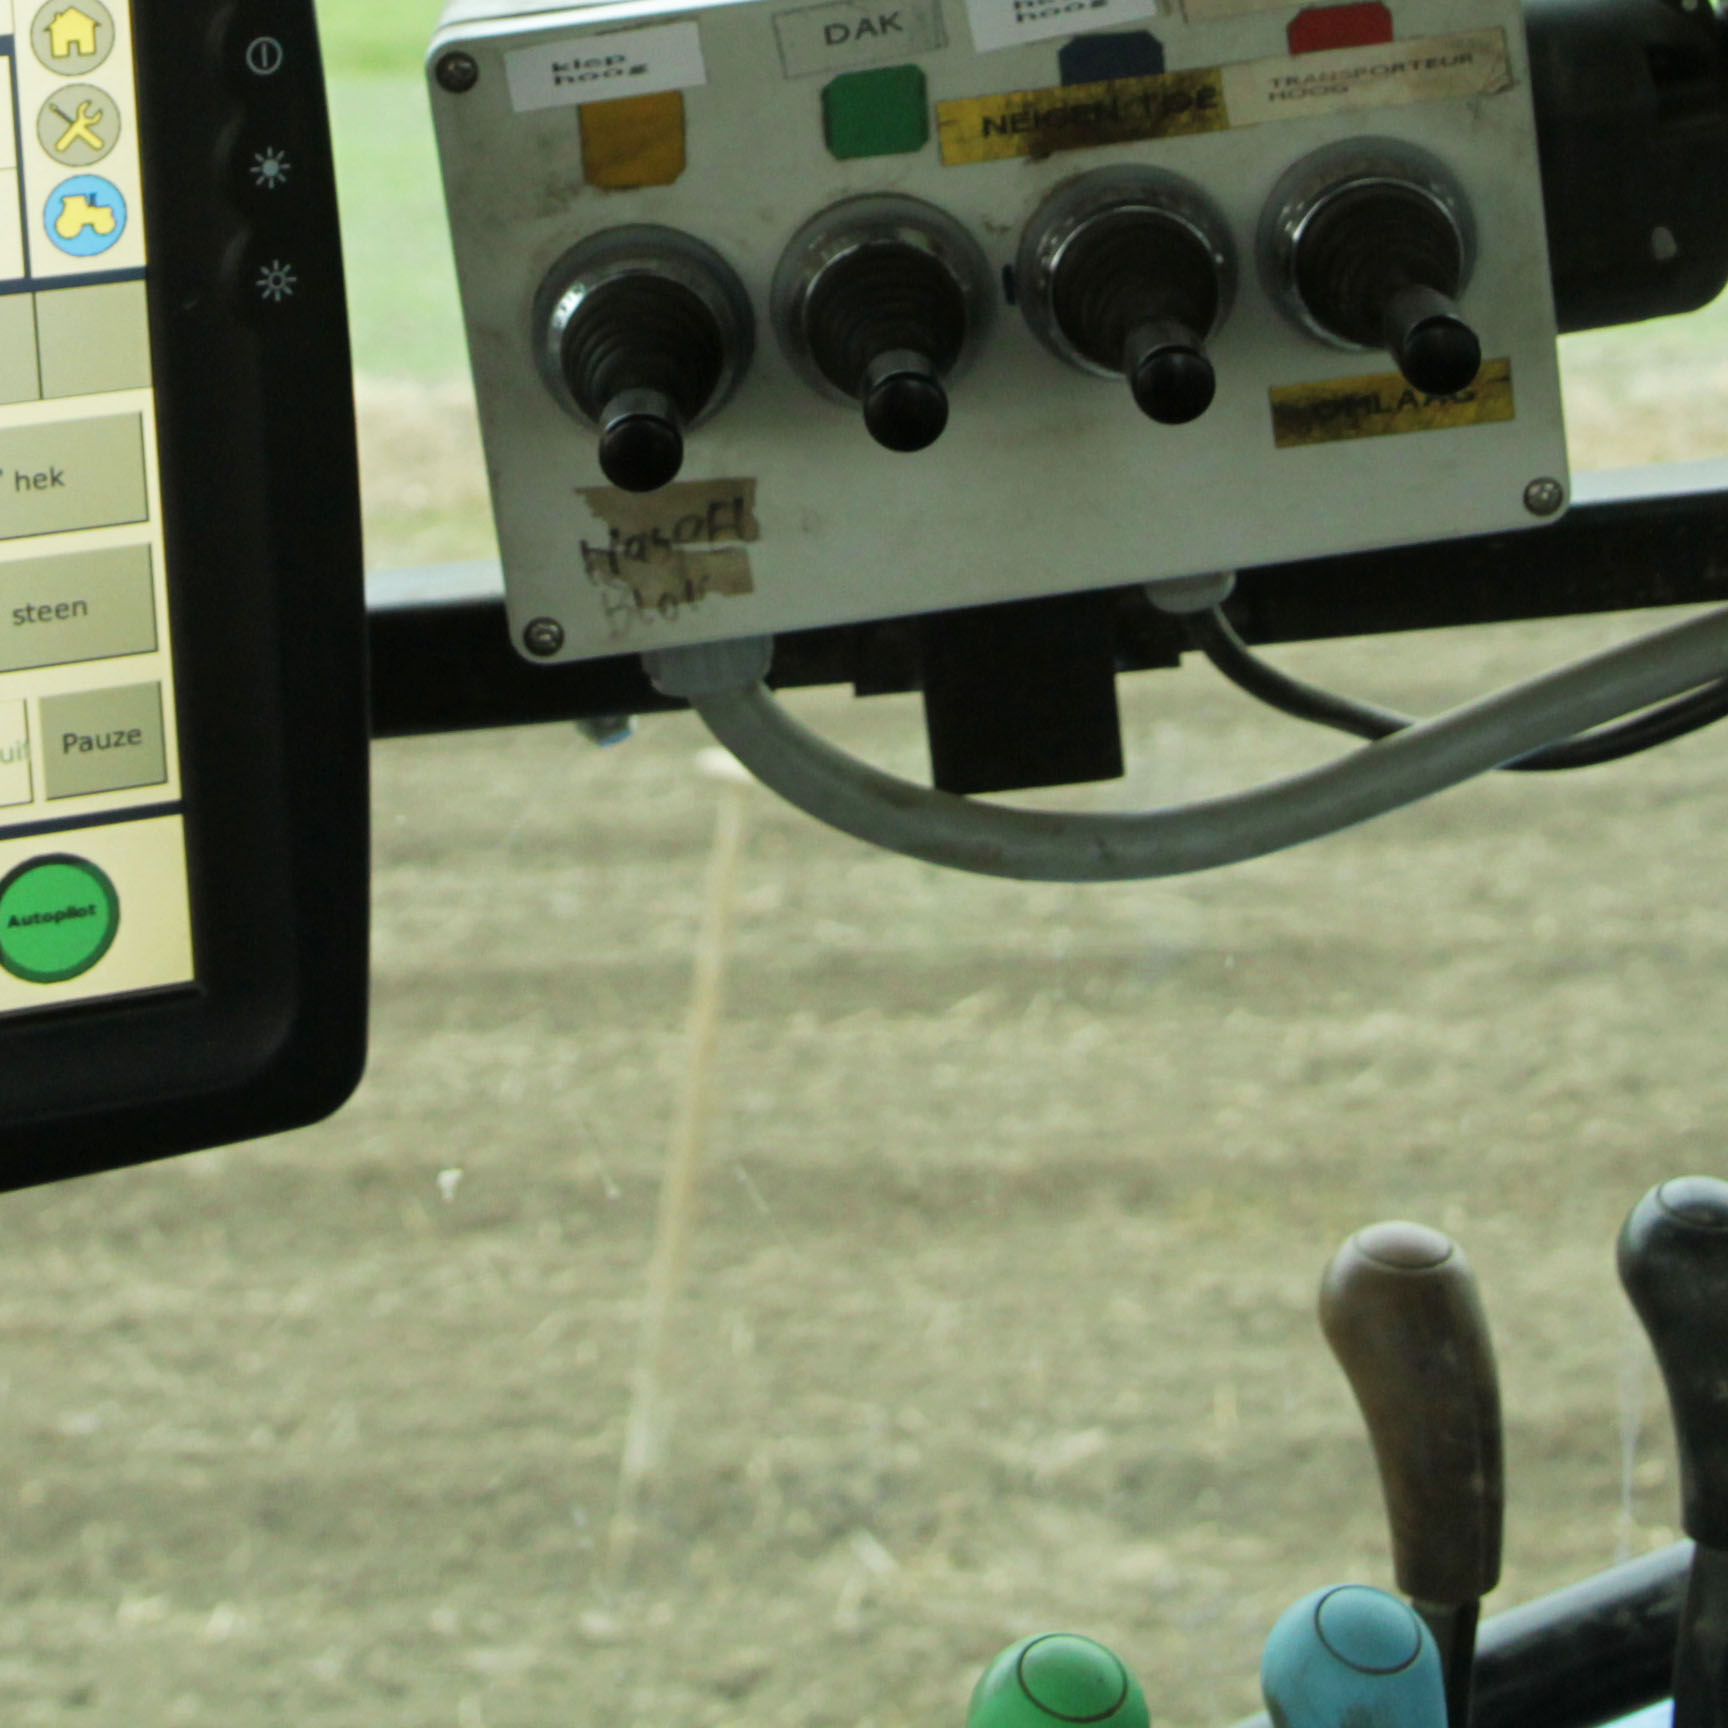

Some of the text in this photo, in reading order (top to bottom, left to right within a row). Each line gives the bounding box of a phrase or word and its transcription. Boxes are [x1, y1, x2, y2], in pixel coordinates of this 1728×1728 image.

[823, 12, 904, 47] DAK
[552, 64, 649, 86] hoog
[14, 466, 66, 493] hek
[11, 596, 89, 628] steen
[62, 725, 143, 756] Pauze
[8, 902, 97, 930] Autopilot
